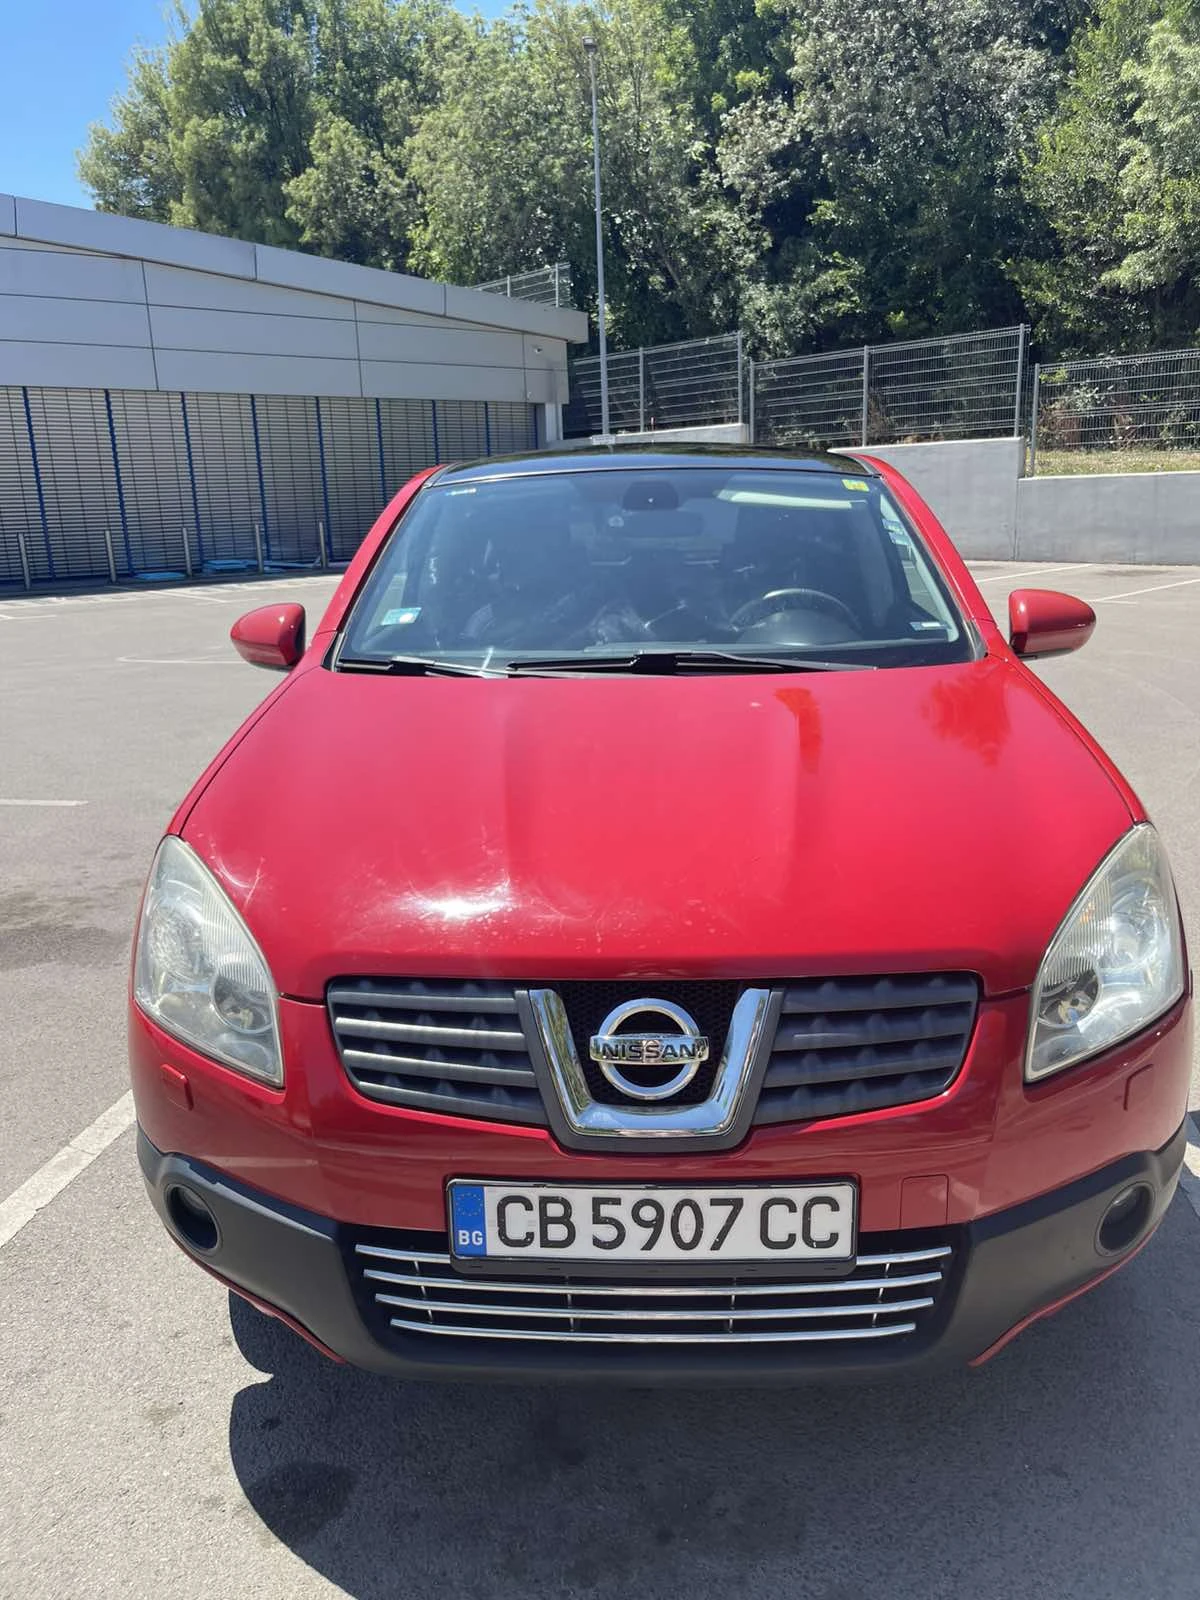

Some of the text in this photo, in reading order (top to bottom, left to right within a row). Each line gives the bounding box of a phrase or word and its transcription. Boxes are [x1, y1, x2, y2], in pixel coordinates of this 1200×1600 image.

[602, 1043, 696, 1060] NISSAN
[496, 1195, 841, 1251] CB 5907 CC
[458, 1230, 483, 1246] BG
